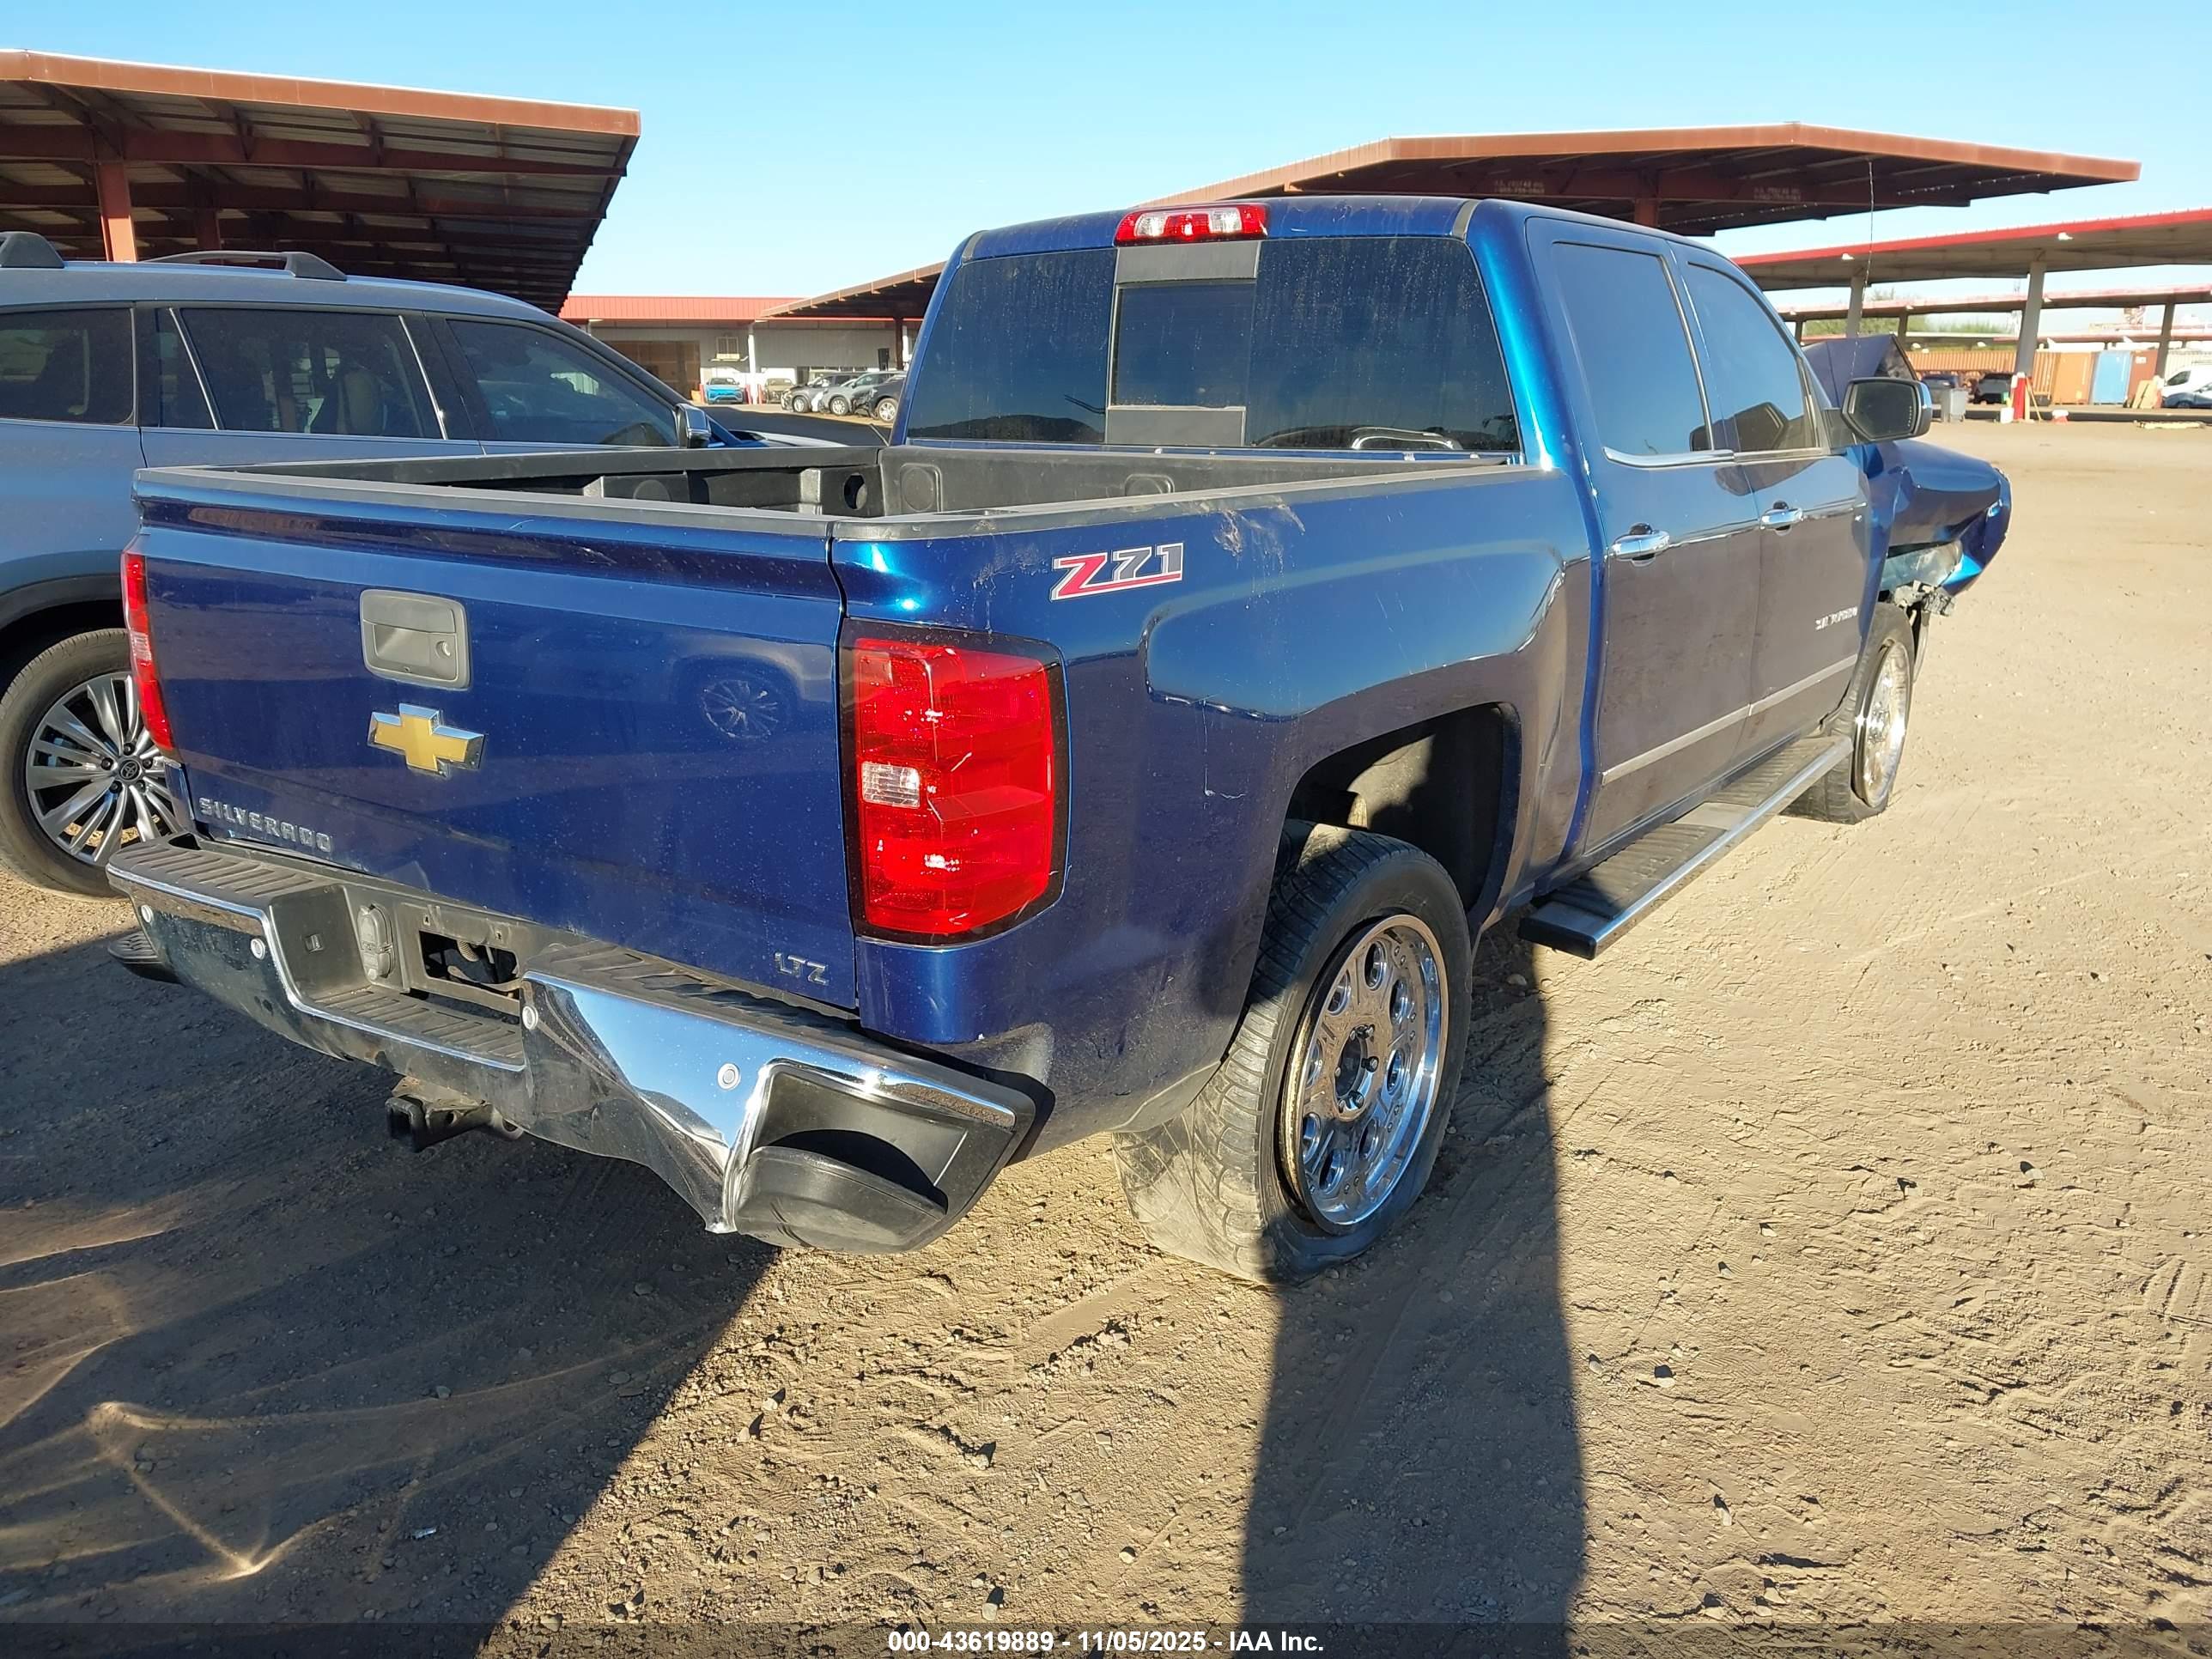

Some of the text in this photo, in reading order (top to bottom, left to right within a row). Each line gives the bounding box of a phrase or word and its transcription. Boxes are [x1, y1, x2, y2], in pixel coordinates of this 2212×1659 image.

[1050, 543, 1184, 601] Z71
[198, 797, 332, 853] SILVERADO
[775, 952, 830, 986] LTZ
